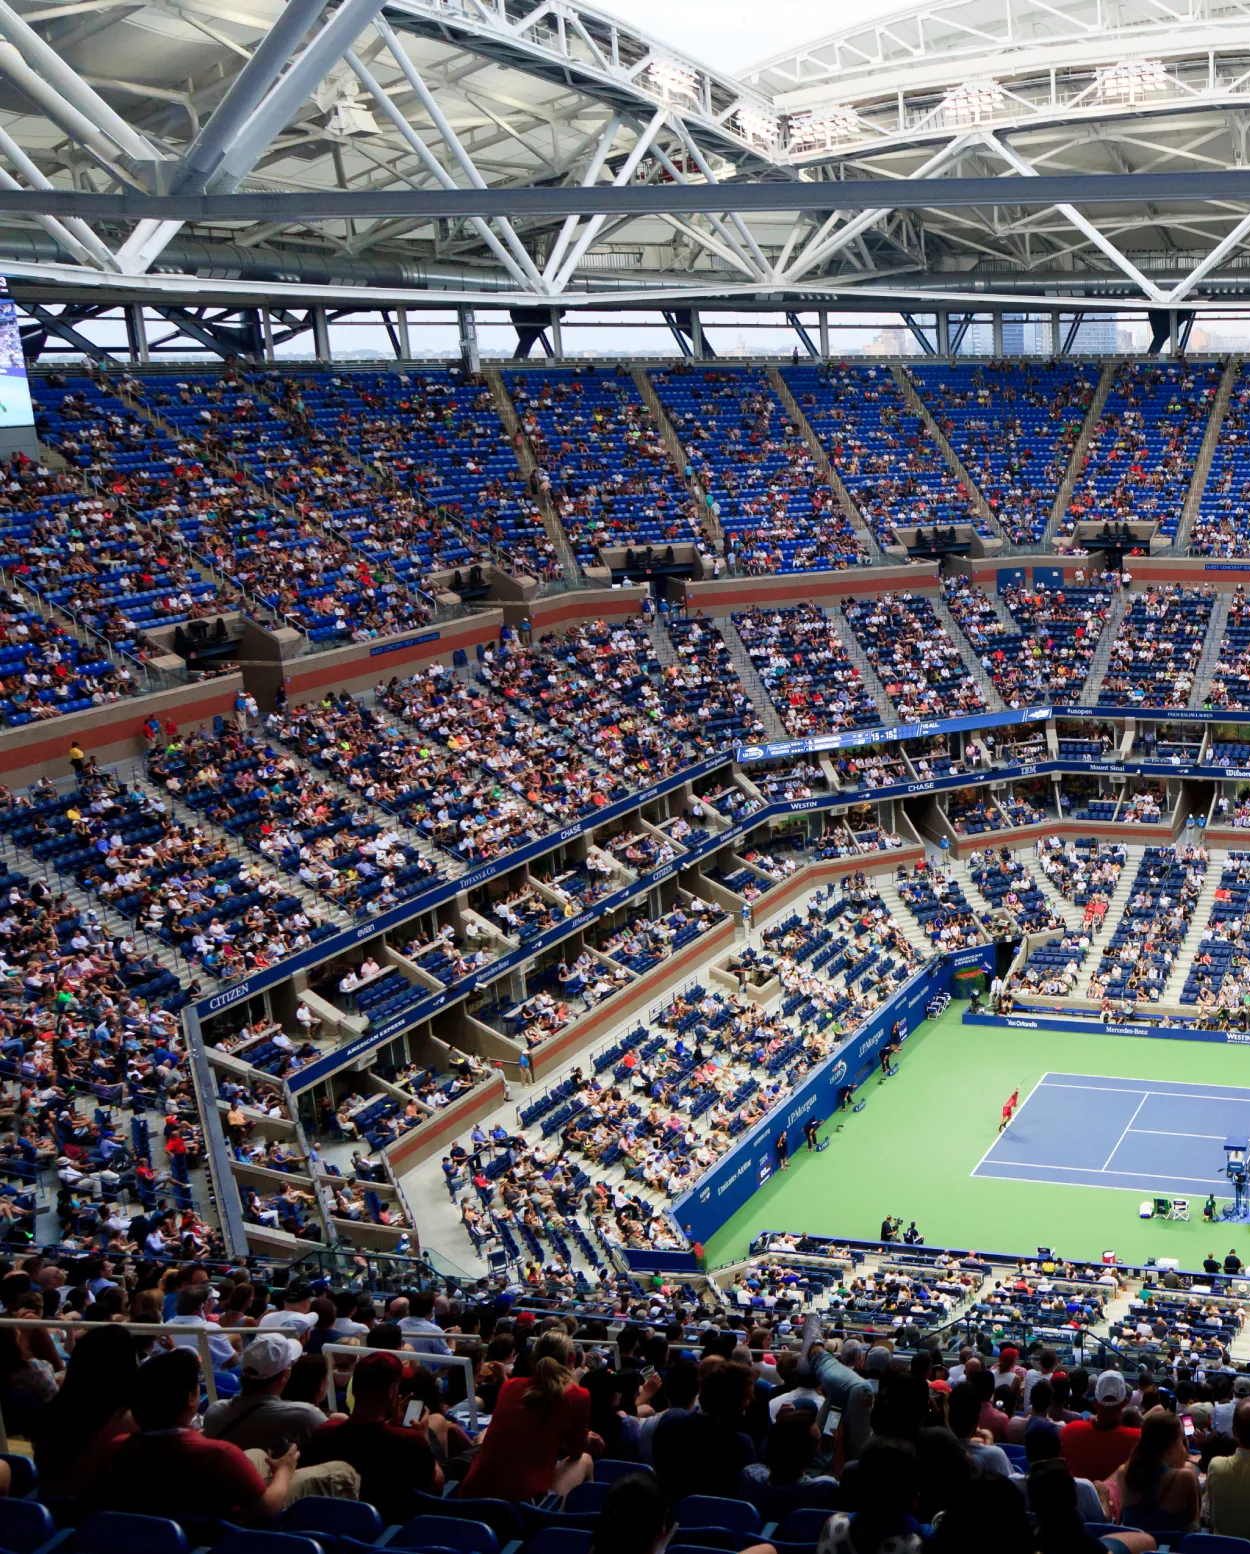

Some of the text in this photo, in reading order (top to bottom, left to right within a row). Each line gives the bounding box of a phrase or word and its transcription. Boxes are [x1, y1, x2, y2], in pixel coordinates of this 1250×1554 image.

[872, 732, 880, 741] 15
[885, 731, 894, 740] 15
[1020, 766, 1037, 775] IBM
[1225, 769, 1250, 778] Wilson
[908, 782, 935, 792] CHASE
[790, 802, 817, 810] WESTIN
[560, 824, 582, 840] CHASE
[652, 864, 673, 881] CITIZEN
[459, 872, 482, 889] TIFFANY
[357, 922, 375, 938] evian
[954, 953, 983, 962] AMERICAN
[954, 958, 978, 966] EXPRESS
[209, 983, 249, 1009] CITIZEN
[1016, 1020, 1038, 1028] Orlando
[1105, 1026, 1148, 1036] Mercedes-Benz
[346, 1018, 406, 1056] AMERICAN EXPRESS
[717, 1173, 737, 1196] Emirates
[737, 1159, 752, 1177] Airline
